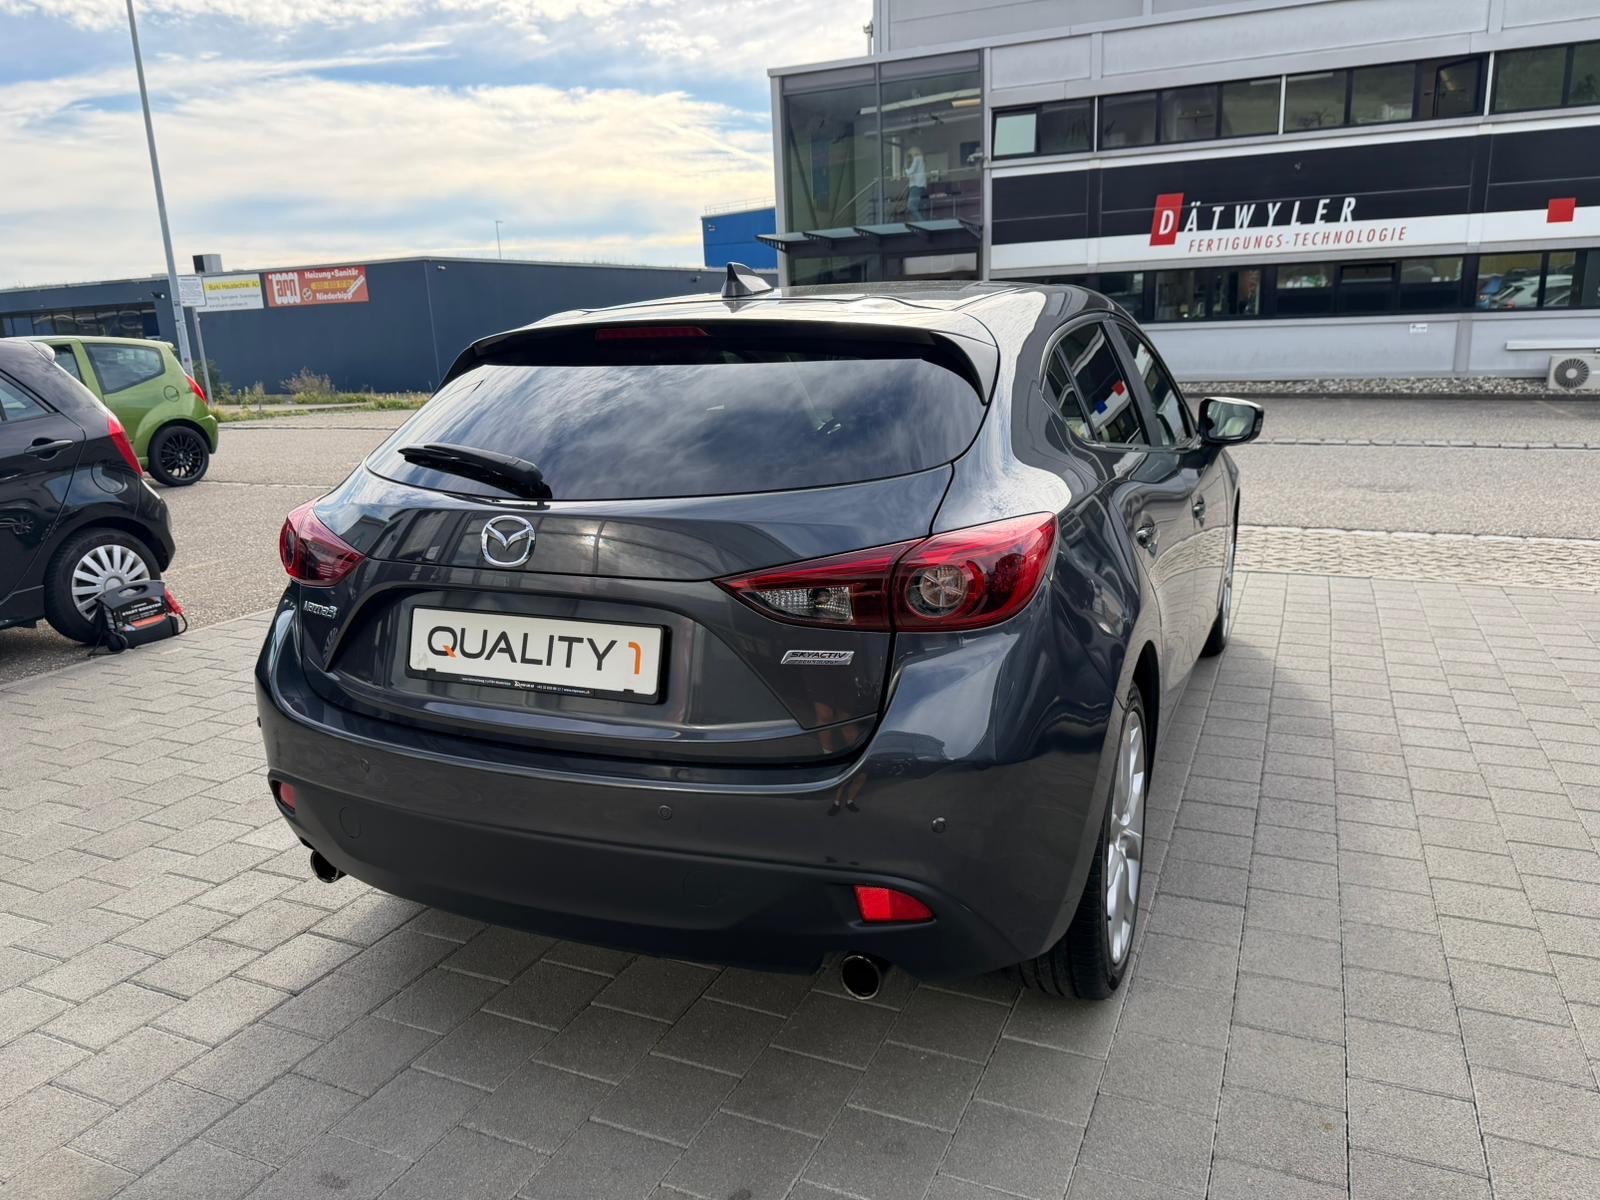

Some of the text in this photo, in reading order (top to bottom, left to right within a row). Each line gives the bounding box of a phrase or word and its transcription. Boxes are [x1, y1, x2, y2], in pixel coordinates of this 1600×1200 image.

[1158, 196, 1358, 236] DÄTWYLER
[1188, 226, 1408, 253] FERTIGUNGS-TECHNOLOGIE
[427, 625, 642, 676] QUALITY 1
[790, 651, 847, 659] SKYACTIV
